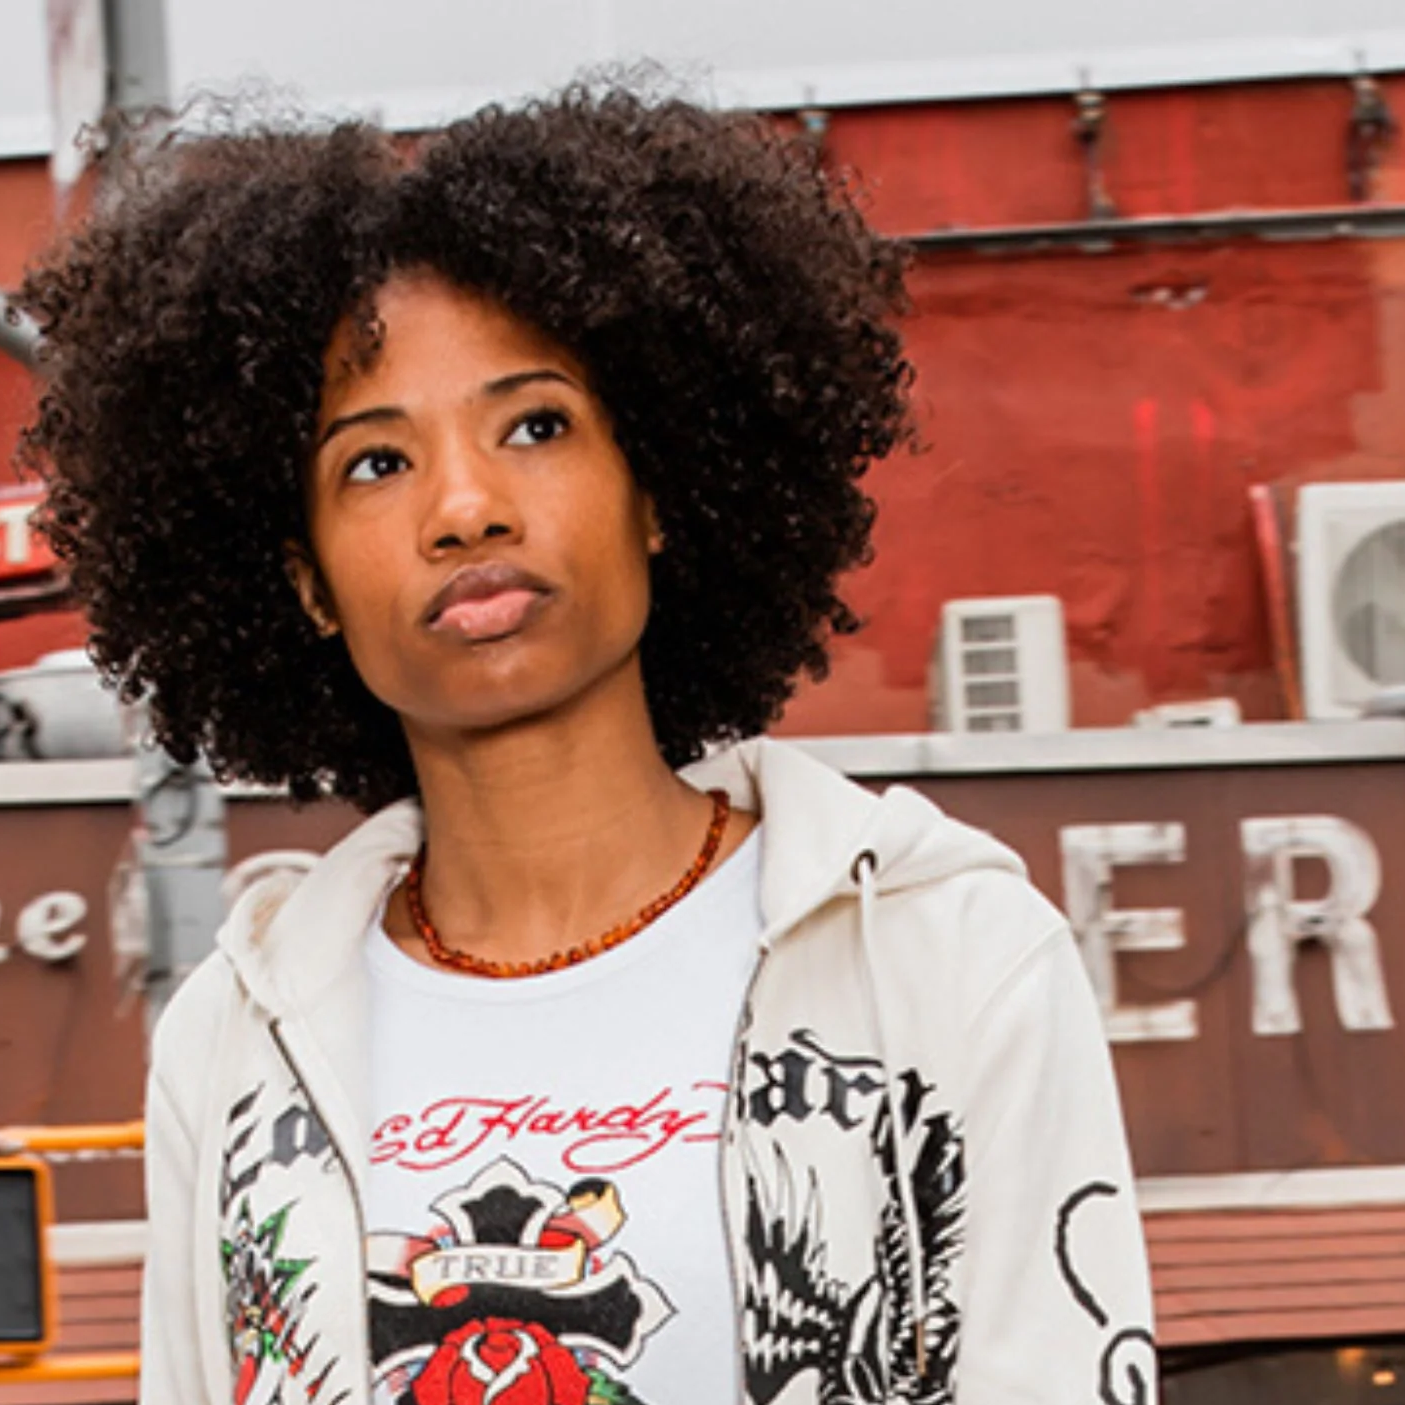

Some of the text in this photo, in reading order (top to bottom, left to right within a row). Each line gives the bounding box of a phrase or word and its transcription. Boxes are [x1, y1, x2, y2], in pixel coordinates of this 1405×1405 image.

[1059, 815, 1396, 1043] ER
[369, 1083, 720, 1174] Ed Hardy
[432, 1254, 559, 1281] TRUE
